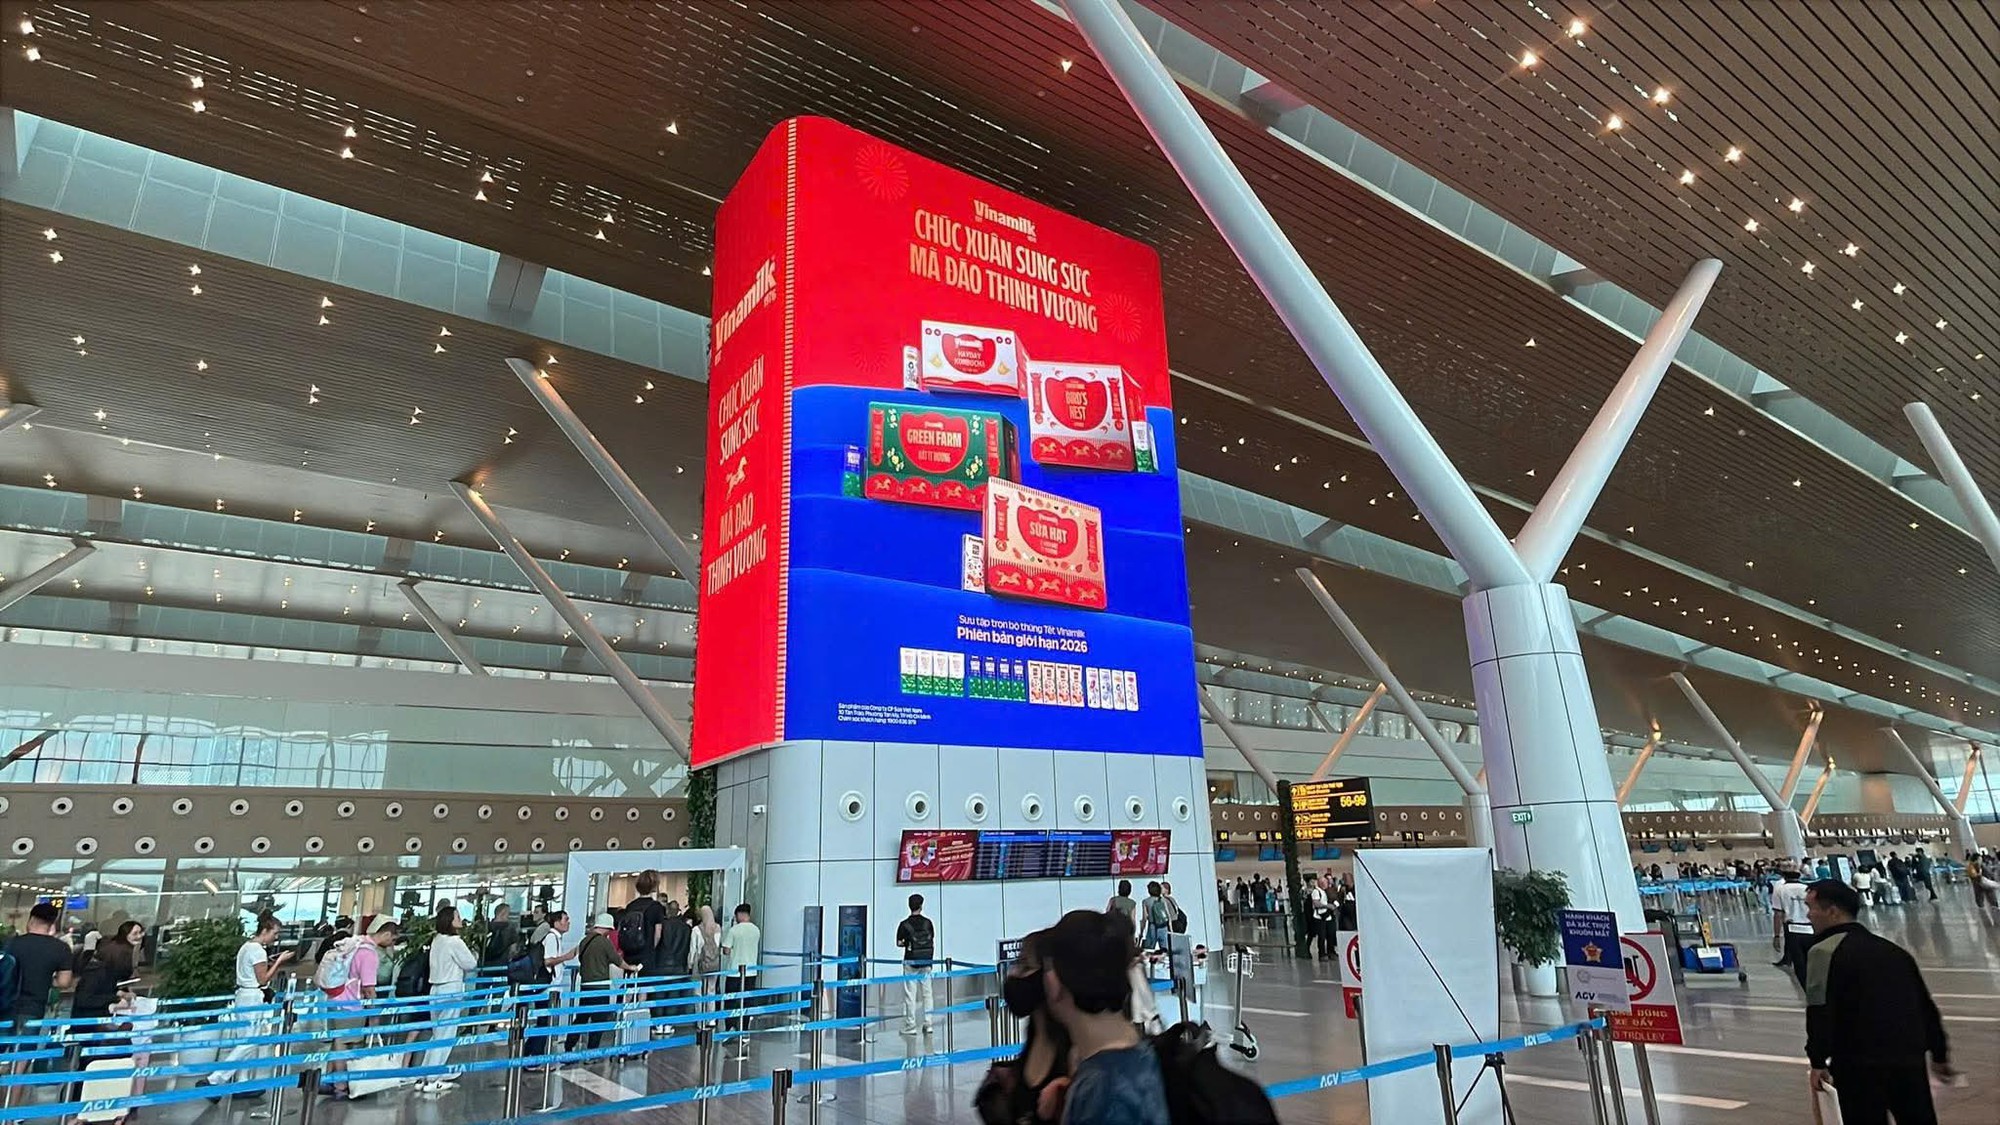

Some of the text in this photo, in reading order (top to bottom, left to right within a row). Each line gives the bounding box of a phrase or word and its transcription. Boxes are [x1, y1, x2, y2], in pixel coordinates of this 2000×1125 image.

[974, 200, 1036, 237] Vinamilk
[915, 209, 1091, 297] CHÚC XUÂN SUNG SỨC
[910, 243, 1097, 333] MÃ ĐÁO THỊNH VƯỢNG
[716, 258, 777, 351] Vinamilk
[719, 355, 764, 429] CHÚC XUÂN
[1069, 406, 1086, 420] NEST
[720, 398, 760, 466] SUNG SỨC
[907, 429, 962, 448] GREEN FARM
[719, 505, 733, 548] MÃ
[707, 549, 732, 597] THỊNH
[959, 614, 975, 625] Sưu
[1056, 627, 1085, 638] Vinamilk
[957, 627, 1088, 653] Phiên bản giới hạn 2026
[51, 899, 63, 908] 12
[1576, 992, 1595, 1000] ACV
[615, 1021, 632, 1029] ACV
[312, 1031, 328, 1039] TIA
[457, 1036, 477, 1045] ACV
[1624, 1031, 1665, 1040] TROLLEY
[304, 1053, 328, 1063] ACV
[902, 1057, 924, 1069] ACV
[132, 1067, 158, 1077] ACV
[448, 1064, 467, 1073] TIA
[1320, 1072, 1339, 1088] ACV
[693, 1086, 721, 1099] ACV
[82, 1100, 115, 1112] ACV
